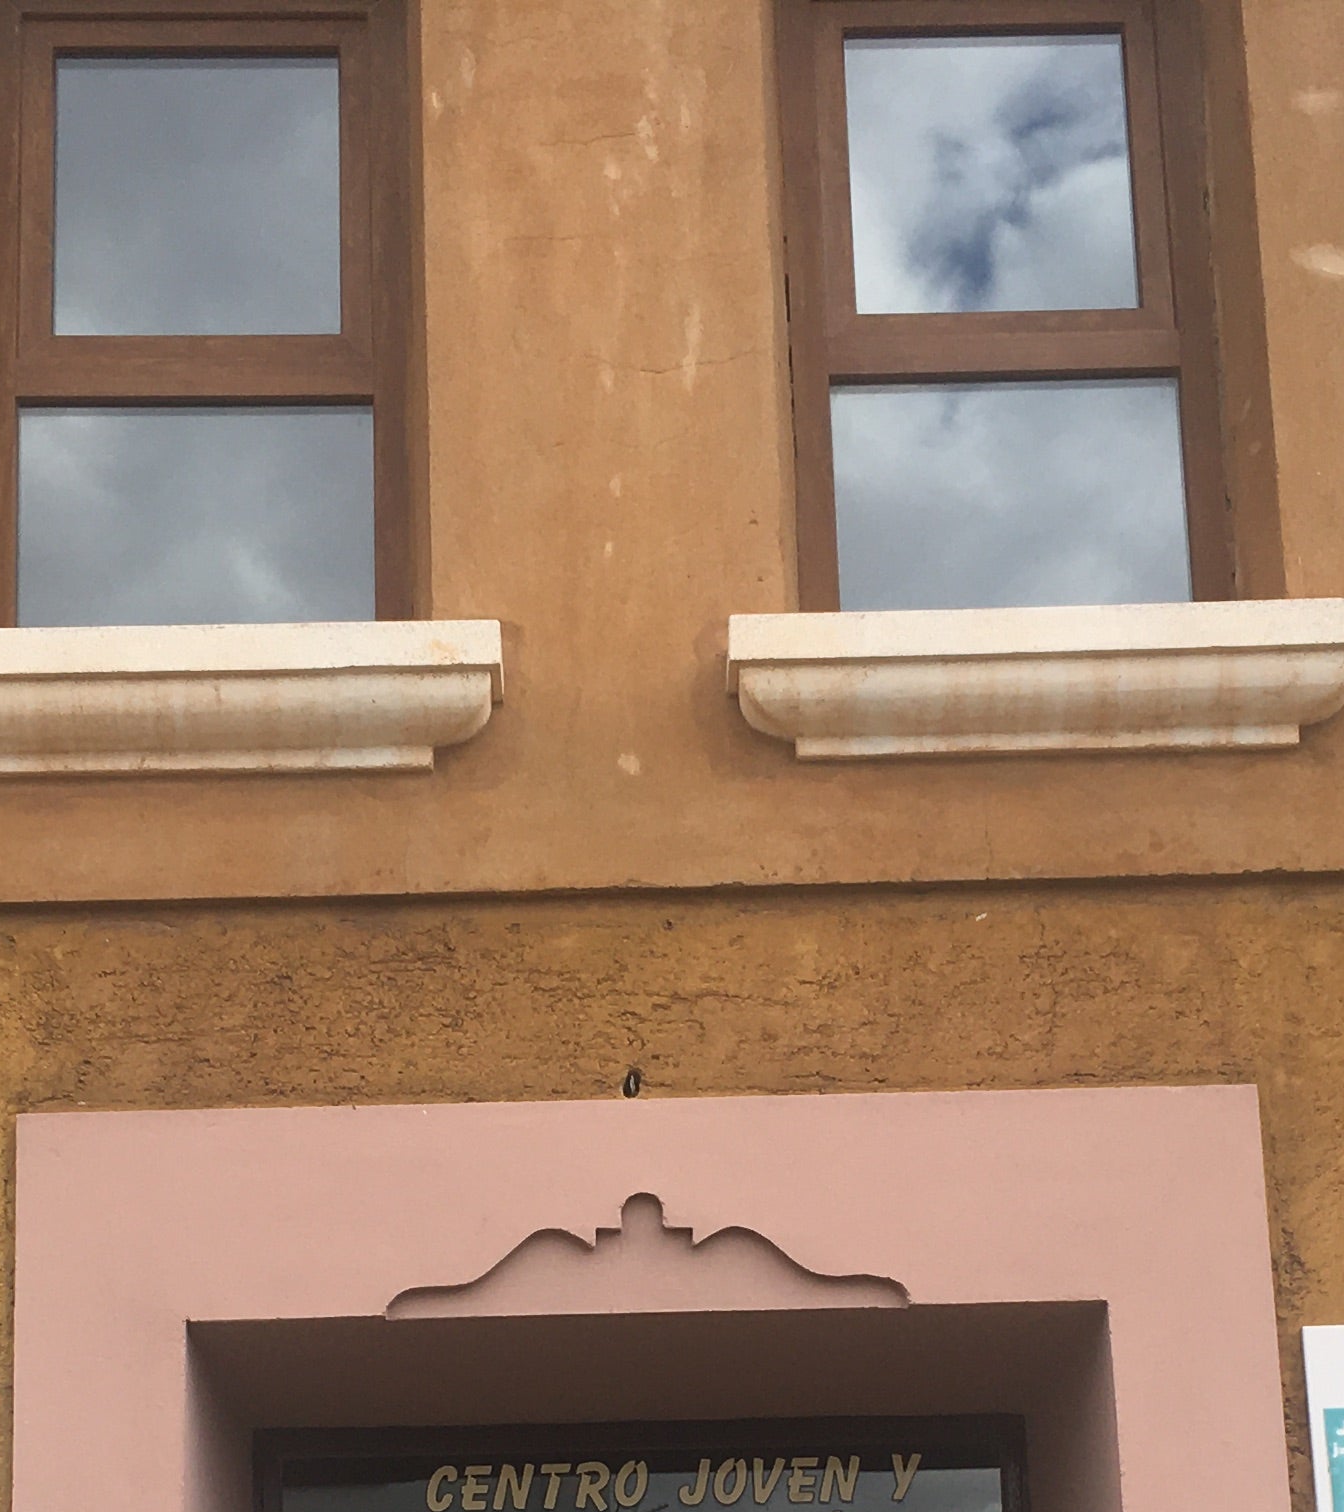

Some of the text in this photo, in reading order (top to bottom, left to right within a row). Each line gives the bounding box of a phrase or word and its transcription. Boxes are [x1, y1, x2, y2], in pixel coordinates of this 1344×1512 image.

[425, 1453, 923, 1512] CENTRO JOVEN Y
